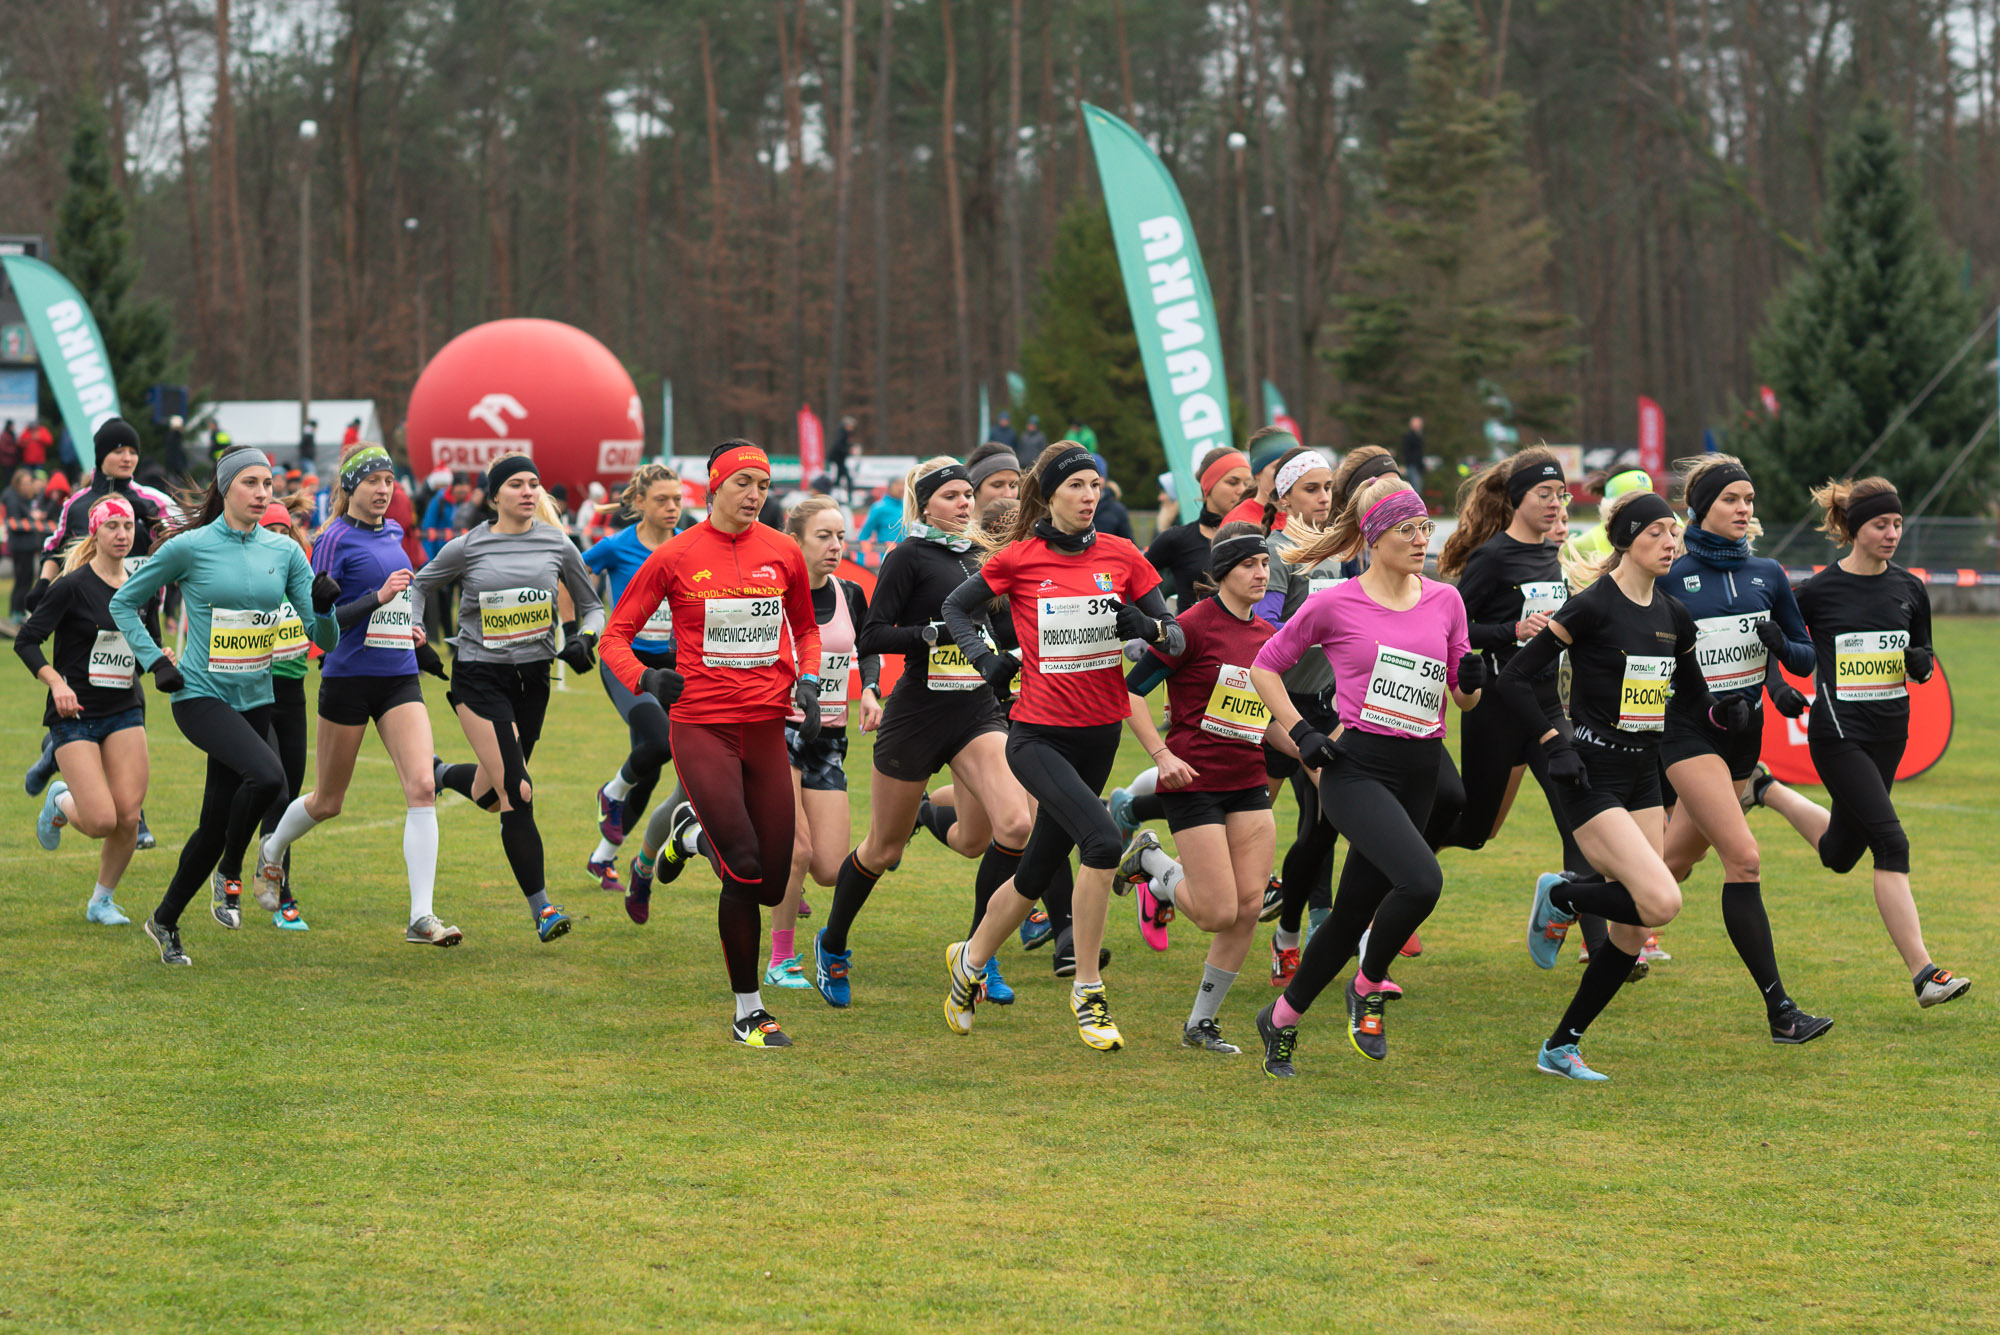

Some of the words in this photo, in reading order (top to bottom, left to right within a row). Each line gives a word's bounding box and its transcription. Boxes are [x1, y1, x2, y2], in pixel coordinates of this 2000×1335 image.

[518, 590, 547, 603] 600
[698, 587, 741, 599] PODLASIE
[751, 600, 780, 617] 328
[252, 613, 278, 626] 307
[484, 608, 550, 628] KOSMOWSKA
[213, 633, 275, 649] SUROWIEC
[707, 624, 778, 642] MIKIEWICZ-ŁAPIŃSKA
[1879, 634, 1906, 650] 596
[1699, 642, 1766, 666] LIZAKOWSKA
[826, 655, 850, 670] 174
[1045, 663, 1081, 671] TOMASZÓW
[1082, 659, 1107, 668] LUBELSKI
[1839, 658, 1903, 676] SADOWSKA
[1419, 660, 1446, 683] 588
[1226, 679, 1246, 688] ORLEN
[1372, 678, 1439, 712] GULCZYŃSKA
[1221, 695, 1266, 718] FIUTEK
[1366, 711, 1402, 727] TOMASZÓW
